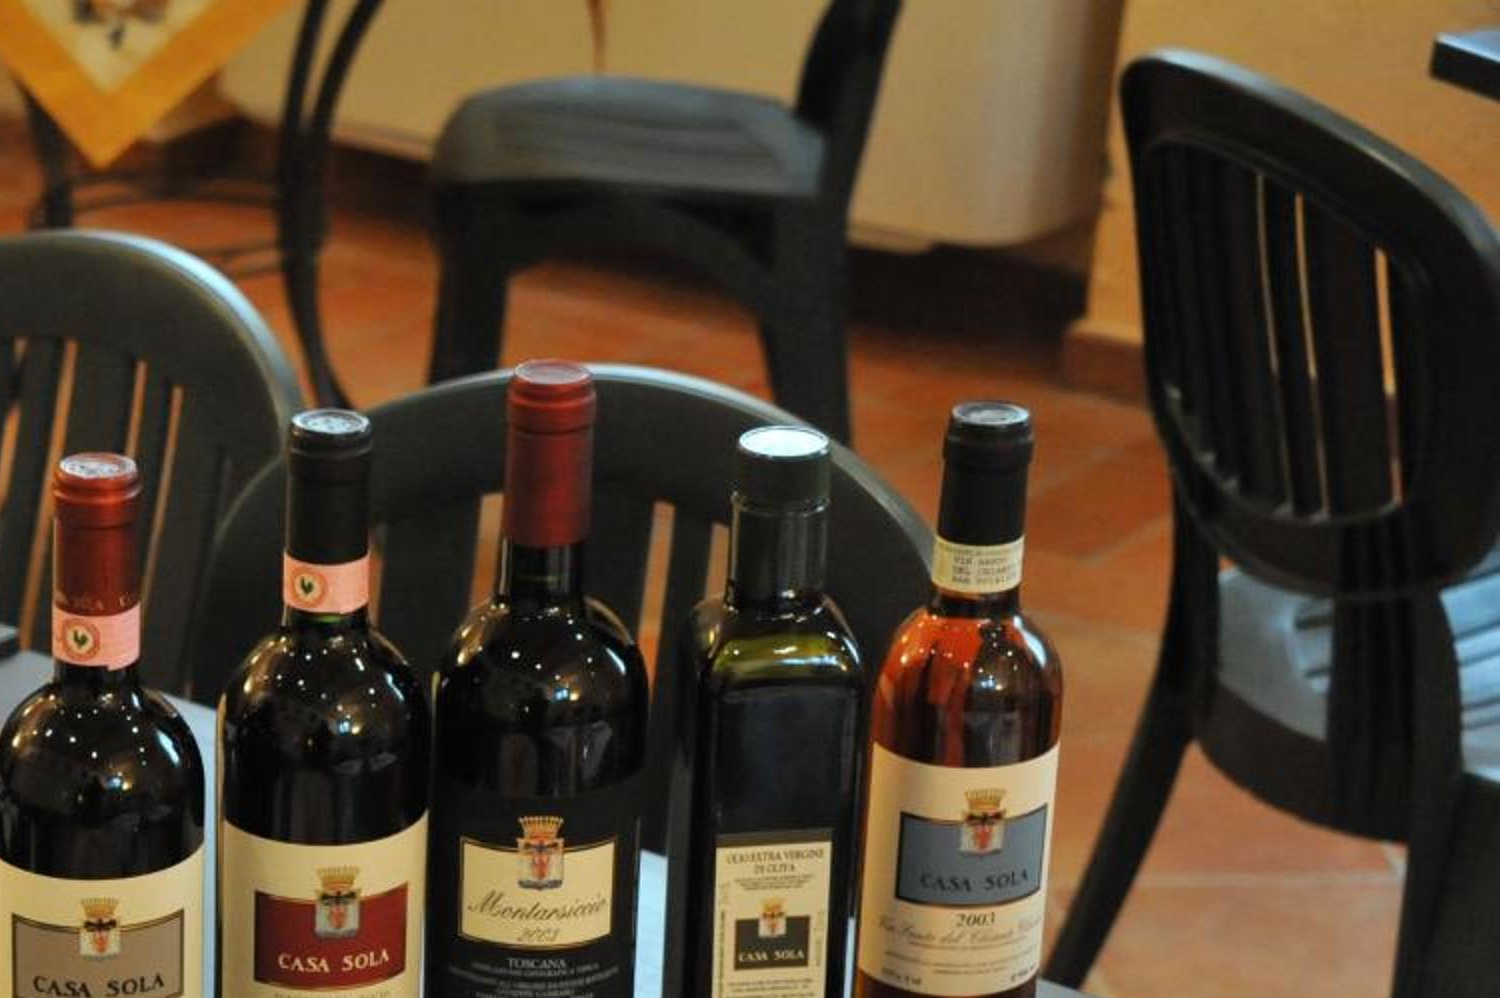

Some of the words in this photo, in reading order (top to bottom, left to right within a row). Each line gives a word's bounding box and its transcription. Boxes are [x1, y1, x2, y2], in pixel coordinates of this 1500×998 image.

[919, 872, 971, 893] CASA
[982, 869, 1030, 892] SOLA
[955, 911, 997, 927] 2003
[277, 952, 331, 973] CASA
[342, 949, 390, 972] SOLA
[507, 957, 567, 969] TOSCANA
[774, 948, 805, 961] SOLA
[32, 974, 92, 998] CASA
[105, 974, 166, 998] SOLA
